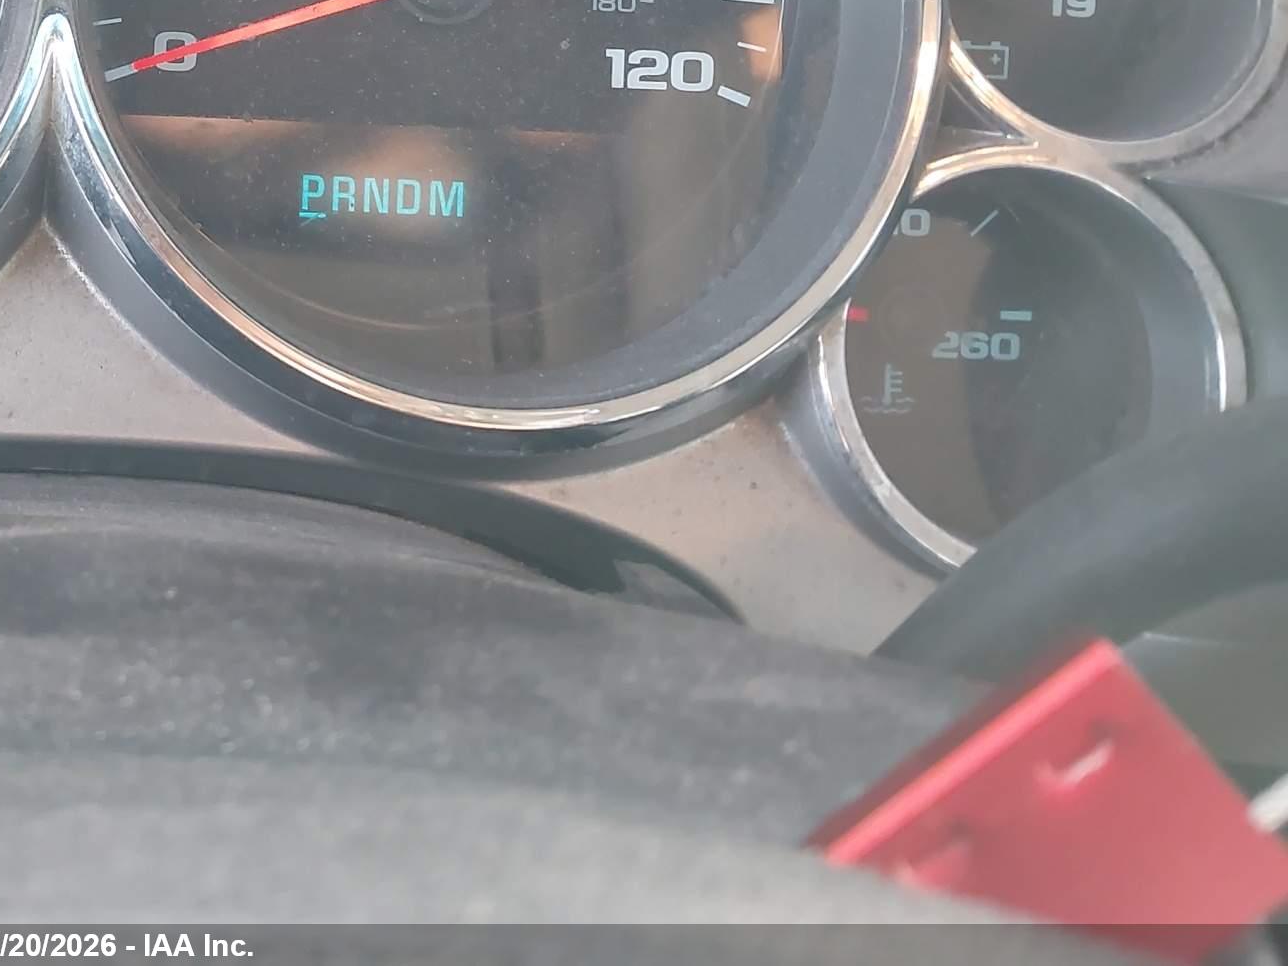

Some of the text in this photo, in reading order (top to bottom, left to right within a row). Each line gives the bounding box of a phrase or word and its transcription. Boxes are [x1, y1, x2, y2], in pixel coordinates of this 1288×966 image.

[153, 31, 199, 72] 0
[605, 48, 714, 91] 120
[931, 332, 1021, 361] 260
